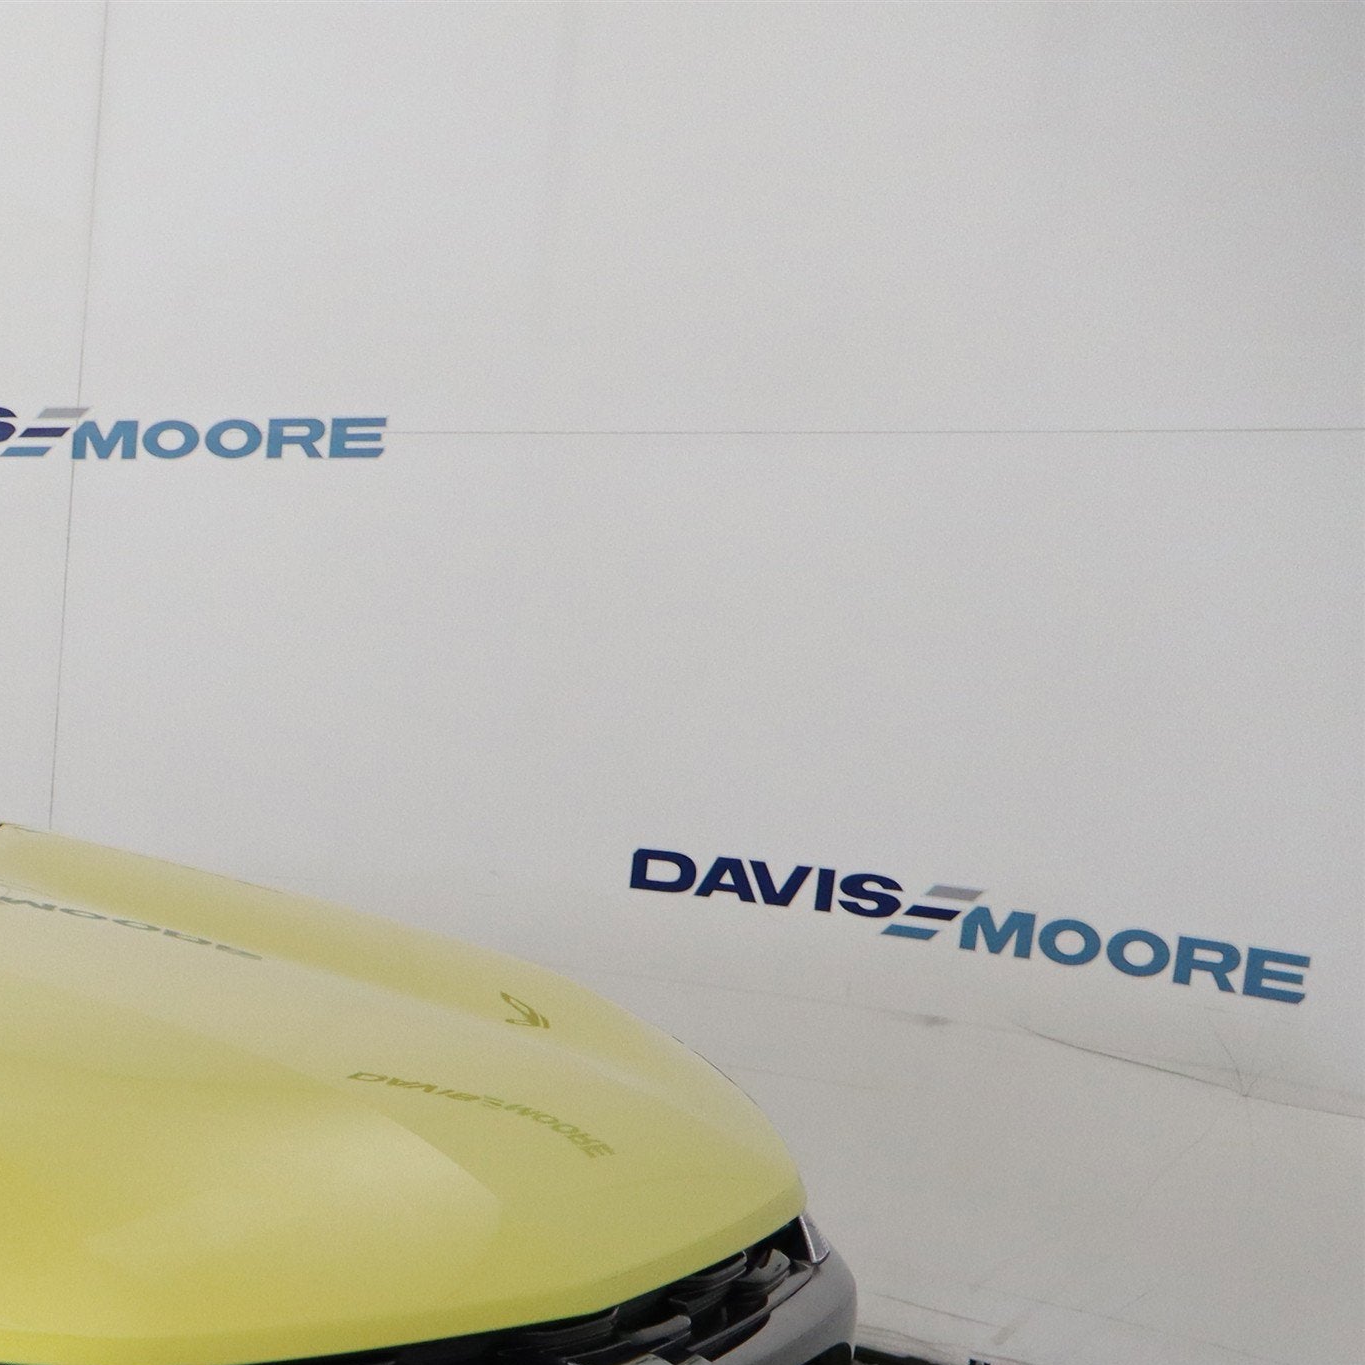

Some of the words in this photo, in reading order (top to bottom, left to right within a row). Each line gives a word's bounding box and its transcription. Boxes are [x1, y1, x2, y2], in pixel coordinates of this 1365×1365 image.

[71, 417, 388, 460] MOORE
[629, 847, 903, 918] DAVIS
[959, 906, 1311, 1005] MOORE
